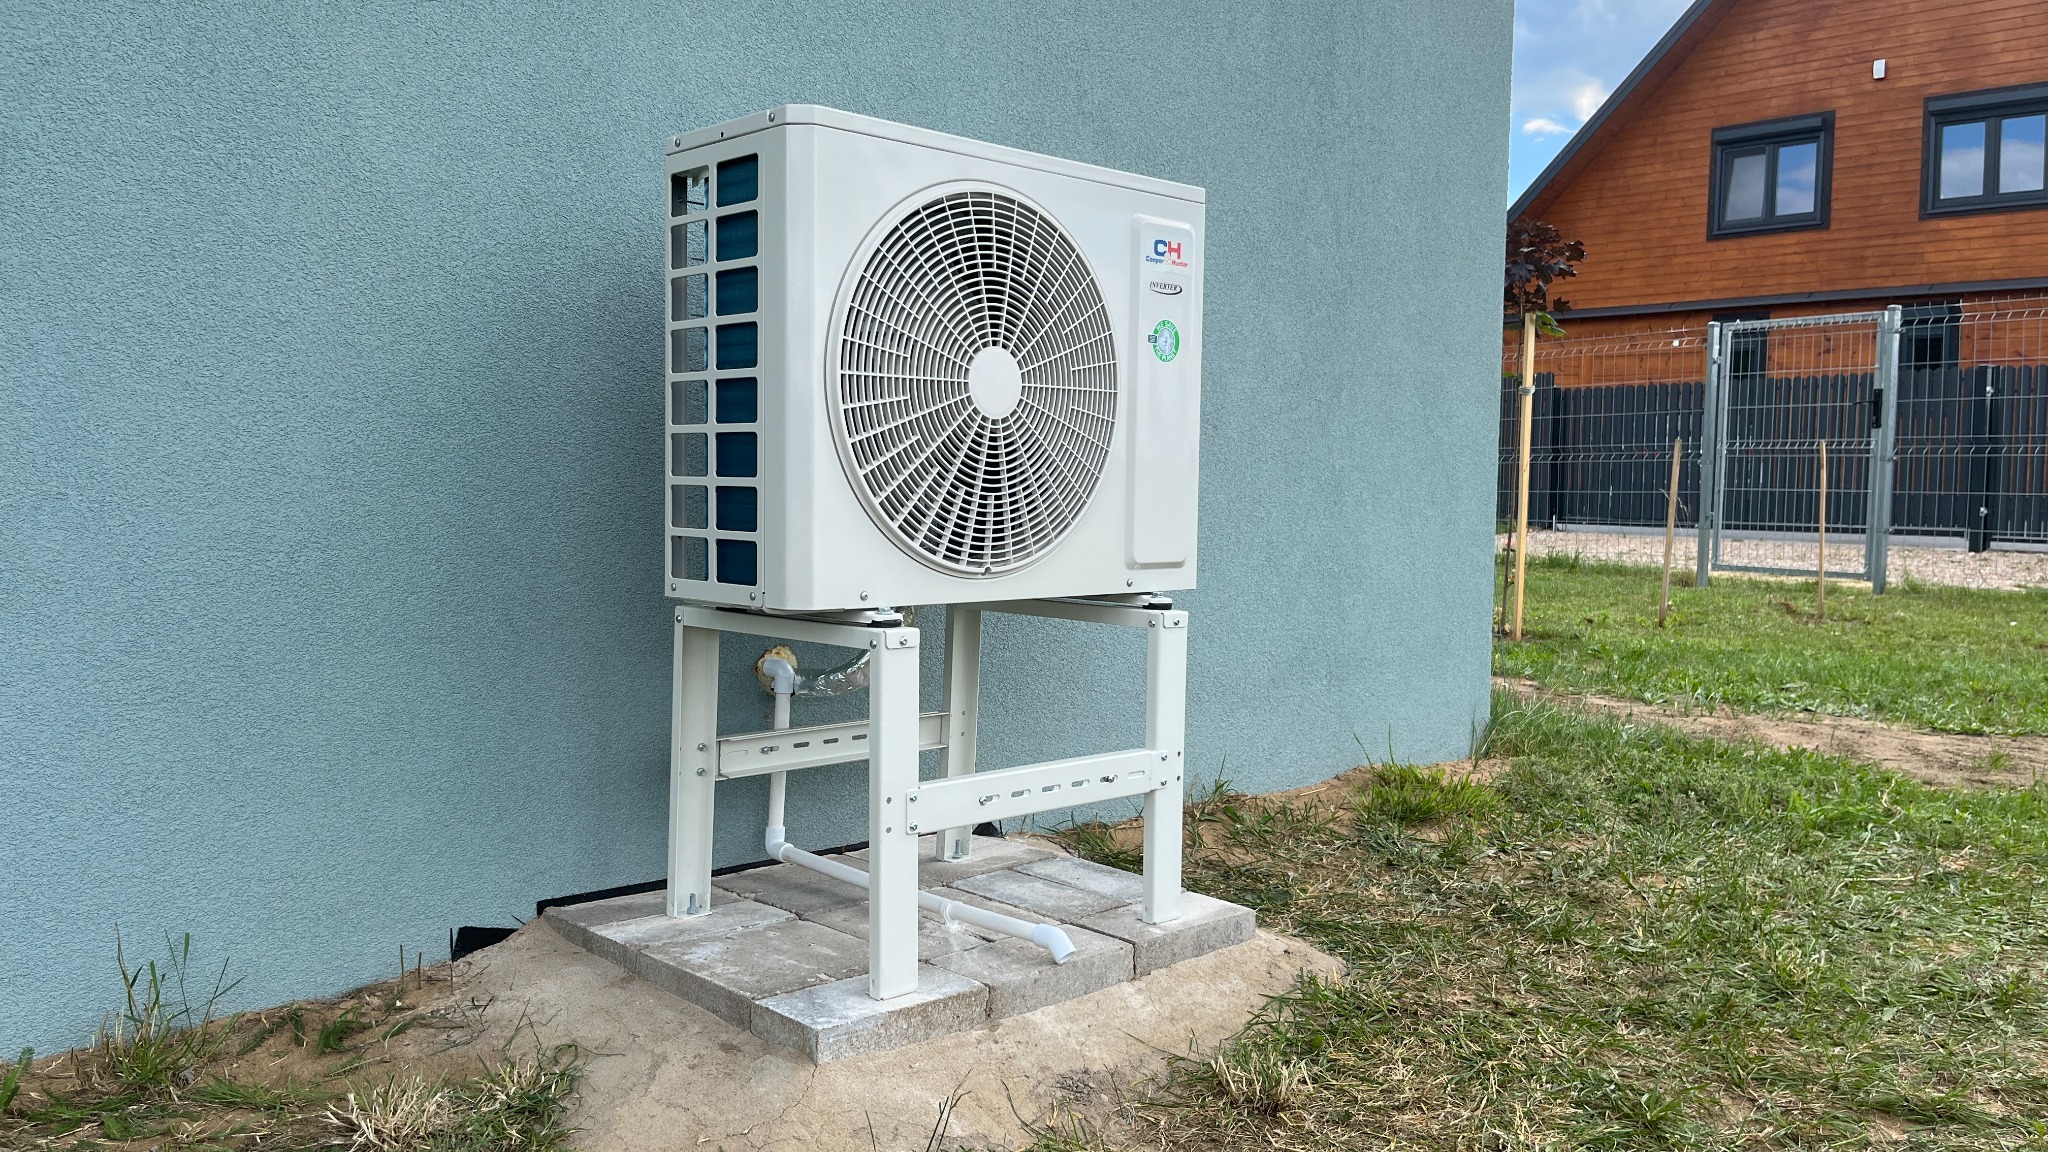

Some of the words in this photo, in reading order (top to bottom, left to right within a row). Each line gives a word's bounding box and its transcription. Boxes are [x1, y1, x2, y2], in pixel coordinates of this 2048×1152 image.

[1153, 239, 1181, 260] CH
[1145, 255, 1164, 264] Cooper
[1171, 259, 1189, 268] Hunter
[1149, 281, 1178, 291] INVERTER
